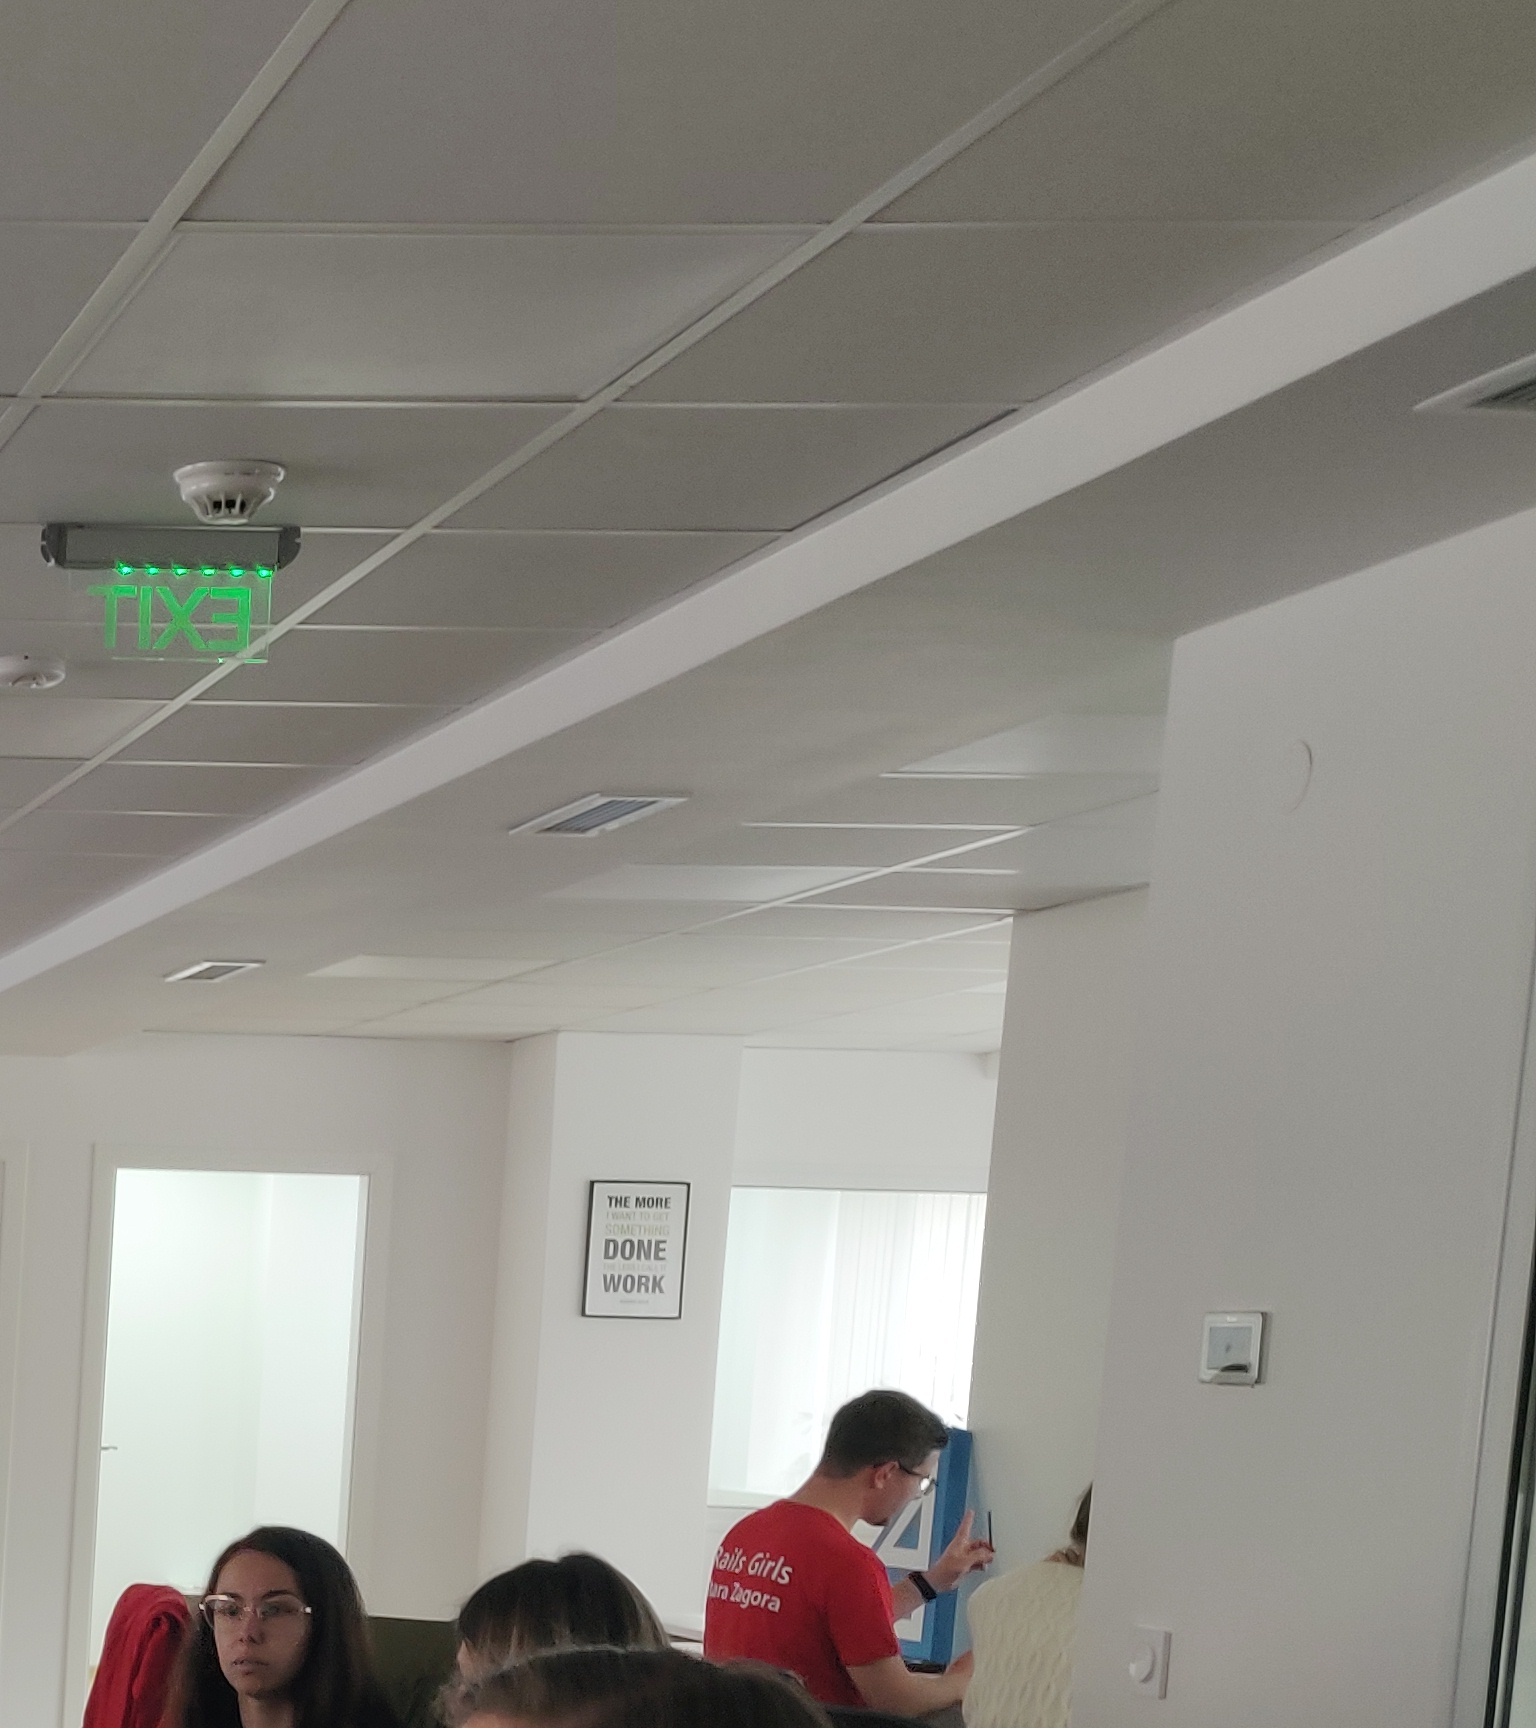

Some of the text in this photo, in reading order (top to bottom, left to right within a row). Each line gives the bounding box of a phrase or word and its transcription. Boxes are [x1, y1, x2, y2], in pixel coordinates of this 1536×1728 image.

[607, 1195, 672, 1210] THE MORE
[605, 1223, 670, 1237] SOMETHING
[603, 1238, 668, 1261] DONE
[602, 1273, 666, 1294] WORK
[714, 1545, 793, 1585] Rails Girls
[730, 1581, 781, 1613] Zagora
